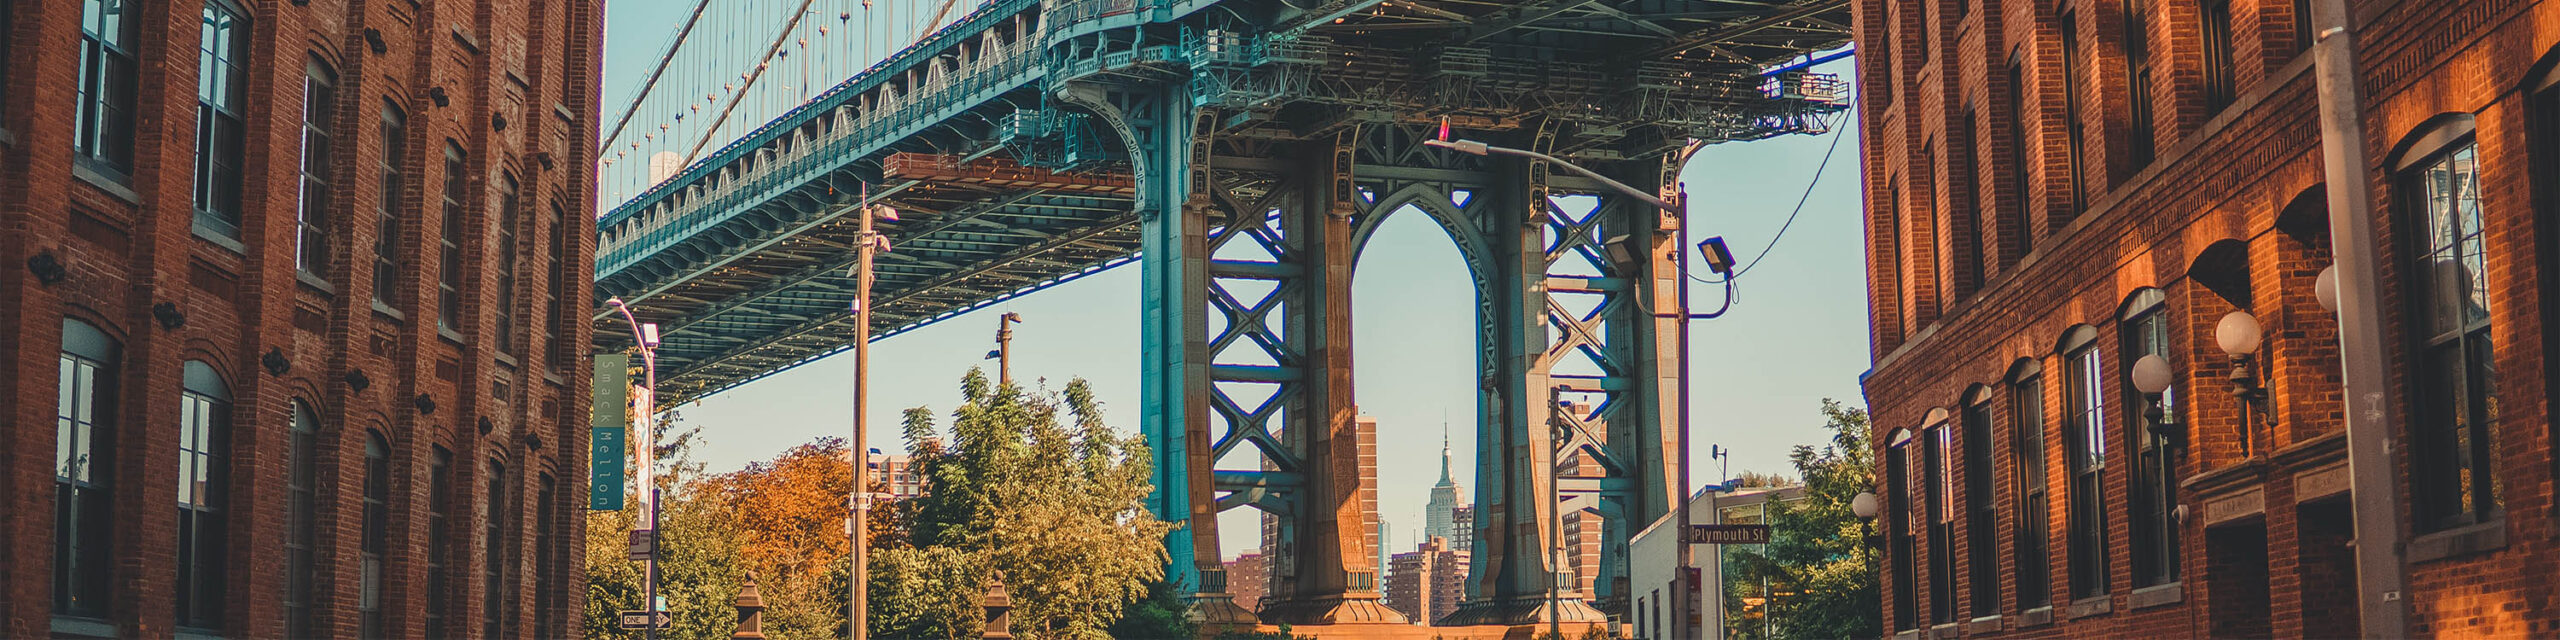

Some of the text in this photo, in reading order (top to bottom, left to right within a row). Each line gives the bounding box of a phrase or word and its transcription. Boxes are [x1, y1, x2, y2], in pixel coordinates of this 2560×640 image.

[599, 361, 615, 505] Smack Mellon
[1694, 527, 1750, 543] Plymouth
[1753, 528, 1764, 541] St
[626, 616, 640, 624] ONE
